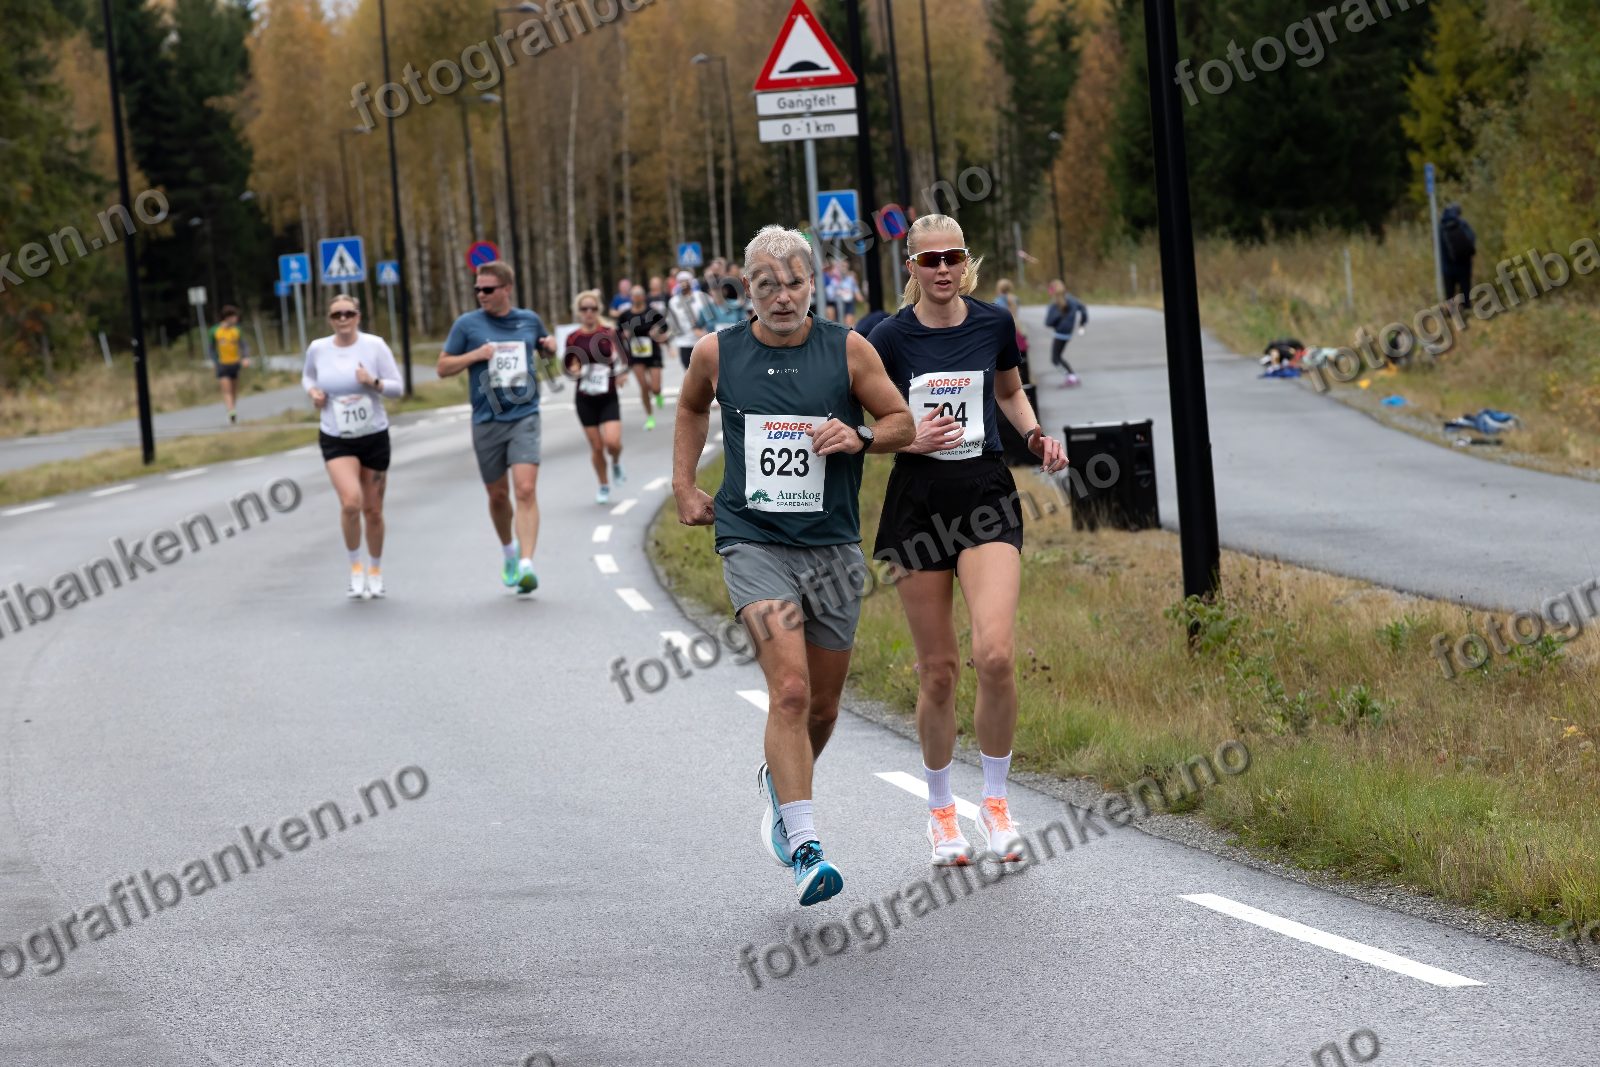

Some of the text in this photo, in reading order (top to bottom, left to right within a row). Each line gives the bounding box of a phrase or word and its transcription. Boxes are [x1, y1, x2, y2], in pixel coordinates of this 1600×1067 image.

[777, 94, 837, 110] Gangfelt
[782, 124, 792, 136] 0
[805, 122, 811, 134] 1
[815, 121, 836, 133] km
[496, 356, 519, 370] 867
[927, 378, 971, 387] NORGES
[931, 387, 964, 395] LØPET
[343, 407, 367, 424] 710
[763, 422, 813, 431] NORGES
[767, 431, 804, 440] LØPET
[760, 447, 810, 477] 623
[777, 490, 821, 503] Aurskog
